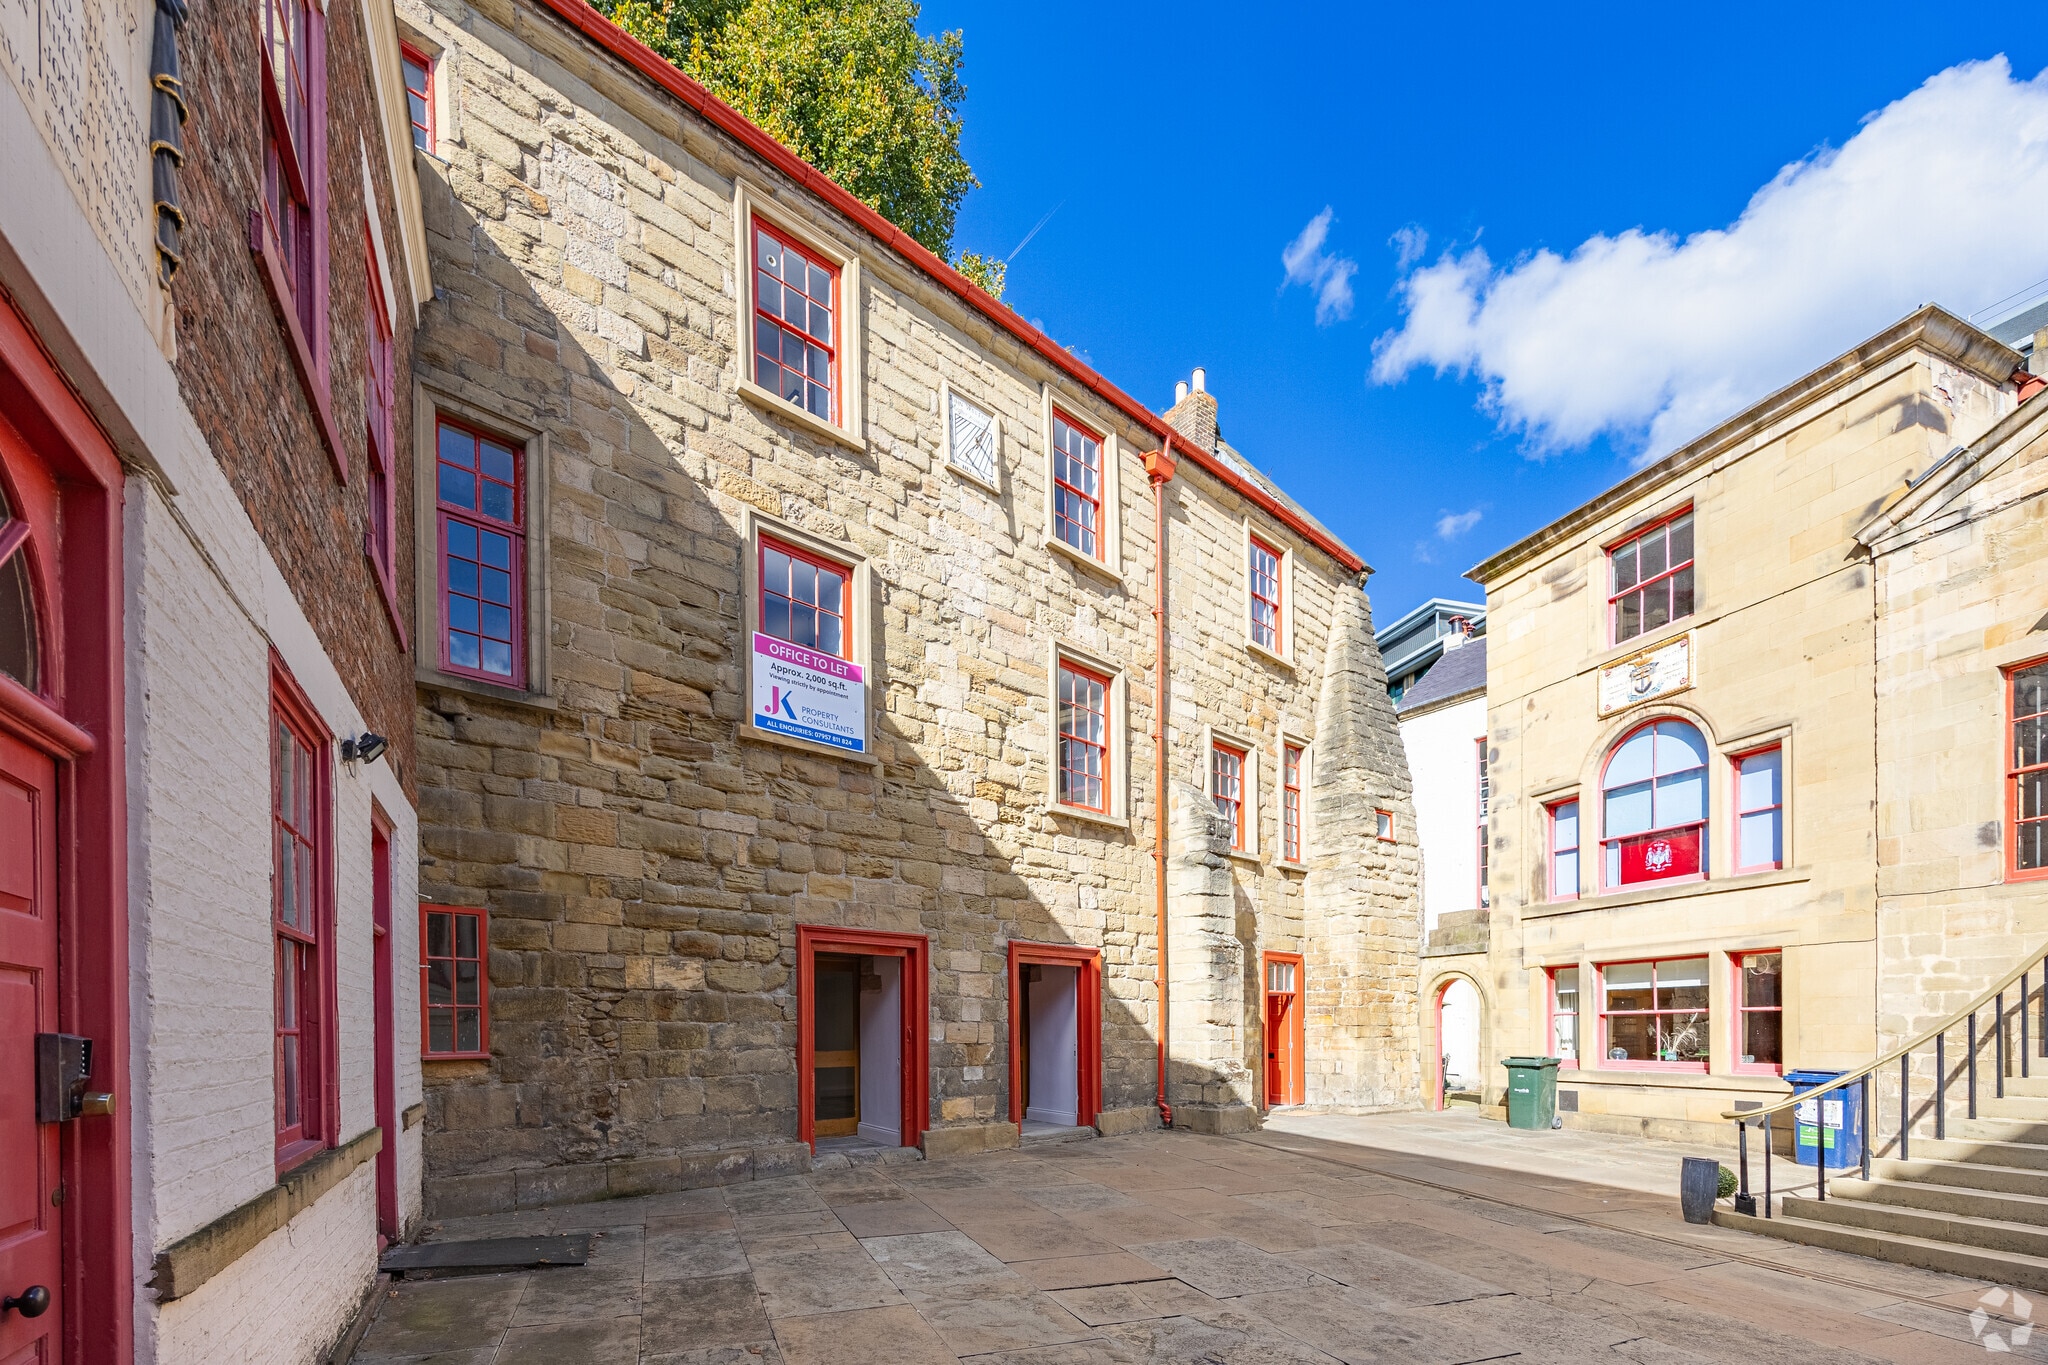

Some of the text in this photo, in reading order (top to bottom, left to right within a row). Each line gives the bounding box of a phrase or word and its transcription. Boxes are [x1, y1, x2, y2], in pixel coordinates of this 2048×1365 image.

[43, 44, 96, 152] JOSEPH
[89, 71, 136, 180] HAWKES
[87, 102, 144, 221] ATKINSON
[45, 72, 151, 287] ISAAC NICHOLSON
[769, 643, 849, 676] OFFICE TO LET
[769, 672, 849, 700] Viewing strictly by appointment
[770, 662, 848, 691] Approx. 2,000 sq.ft.
[766, 720, 778, 729] ALL
[779, 722, 814, 737] ENQUIRIES:
[801, 705, 839, 721] PROPERTY
[801, 715, 855, 735] CONSULTANTS
